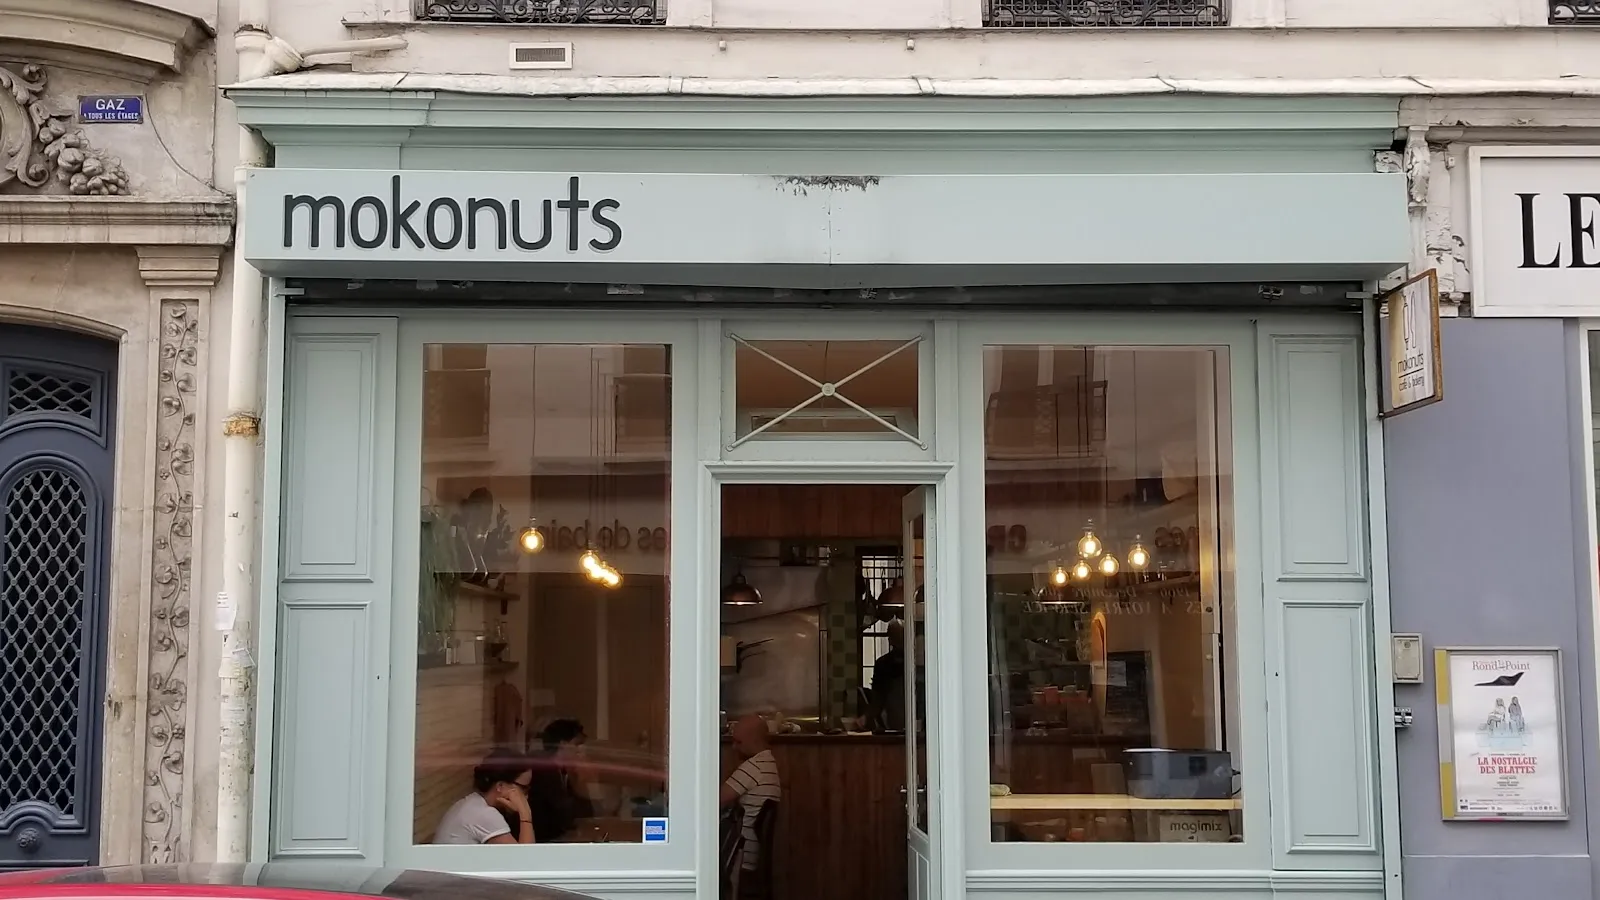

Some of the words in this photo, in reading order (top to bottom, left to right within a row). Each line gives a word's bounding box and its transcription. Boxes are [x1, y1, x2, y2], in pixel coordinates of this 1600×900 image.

[96, 98, 125, 110] GAZ
[88, 112, 103, 120] TOUS
[105, 112, 116, 120] LES
[283, 174, 622, 252] mokonuts
[1397, 351, 1423, 373] mokonuts
[1477, 757, 1489, 765] LA
[1491, 756, 1537, 765] NOSTALGIE
[1480, 765, 1496, 774] DES
[1498, 765, 1536, 774] BLATTES
[1170, 820, 1222, 834] magimix
